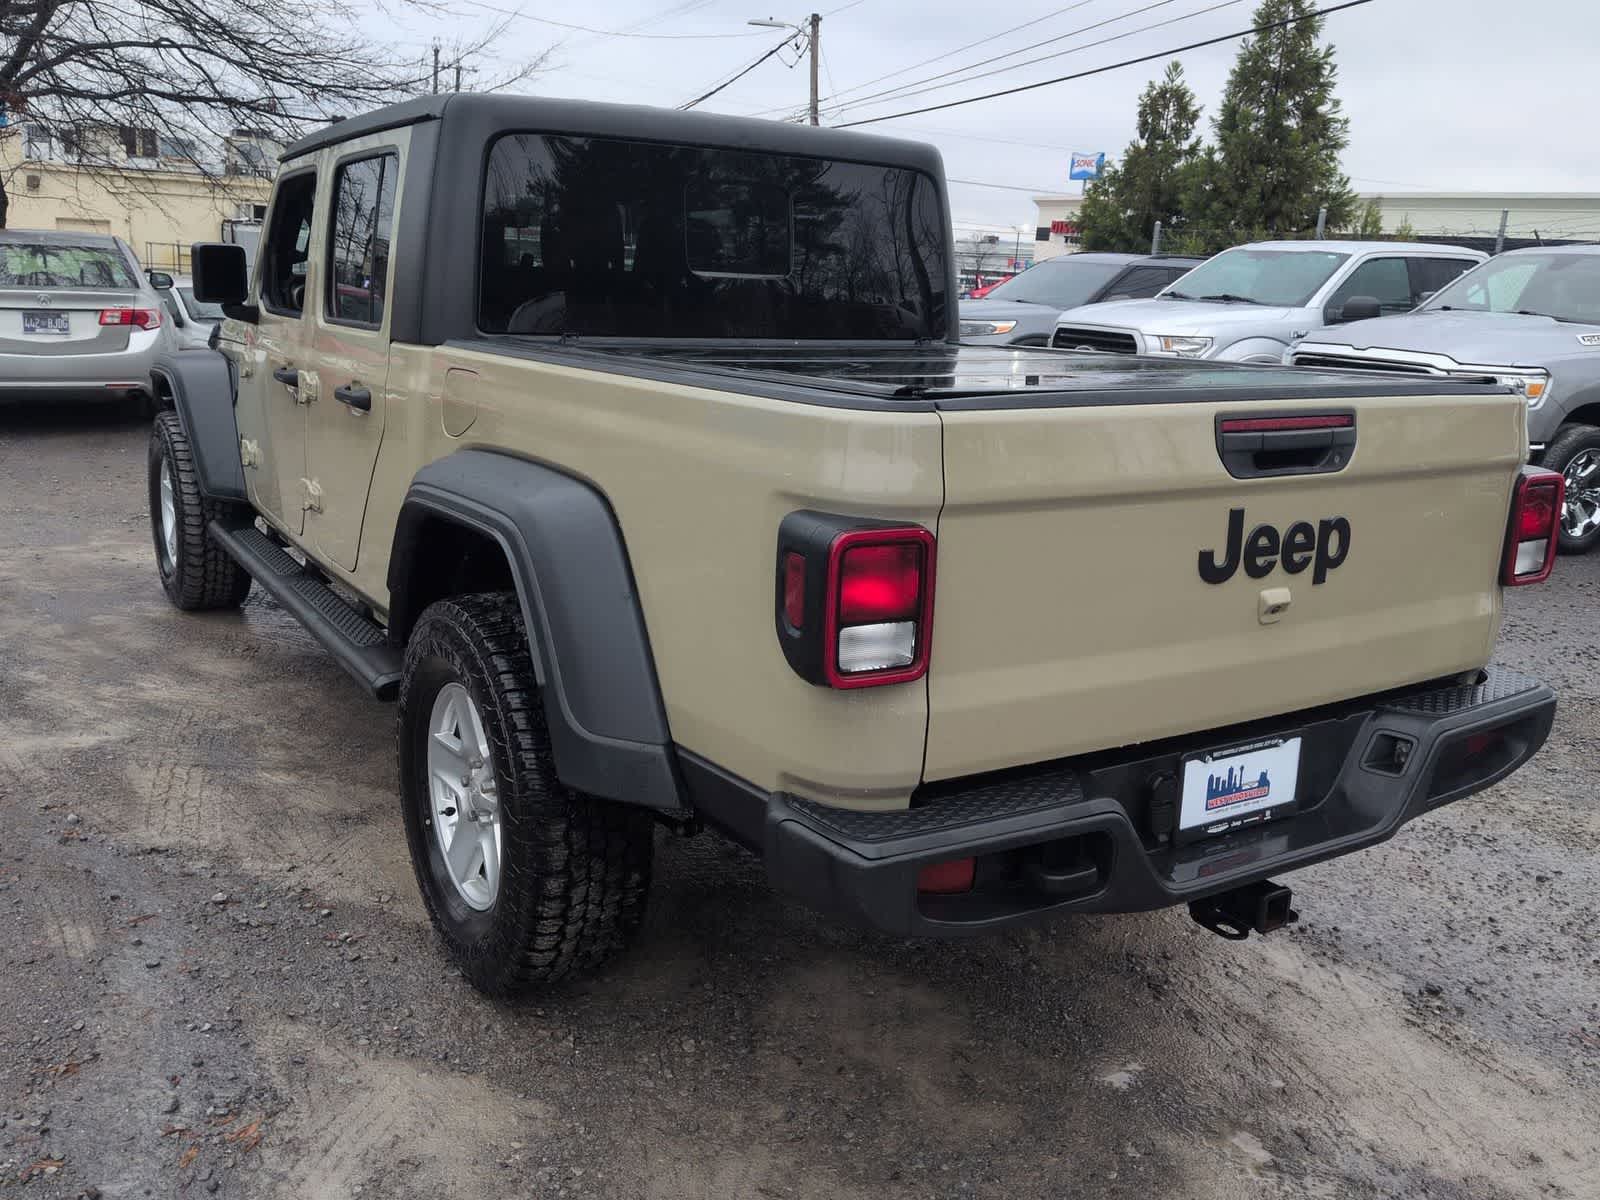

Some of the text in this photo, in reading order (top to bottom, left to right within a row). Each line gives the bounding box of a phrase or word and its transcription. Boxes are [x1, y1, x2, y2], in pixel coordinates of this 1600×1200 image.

[1075, 159, 1095, 168] SONIC
[24, 317, 40, 329] 442
[1198, 507, 1351, 586] Jeep
